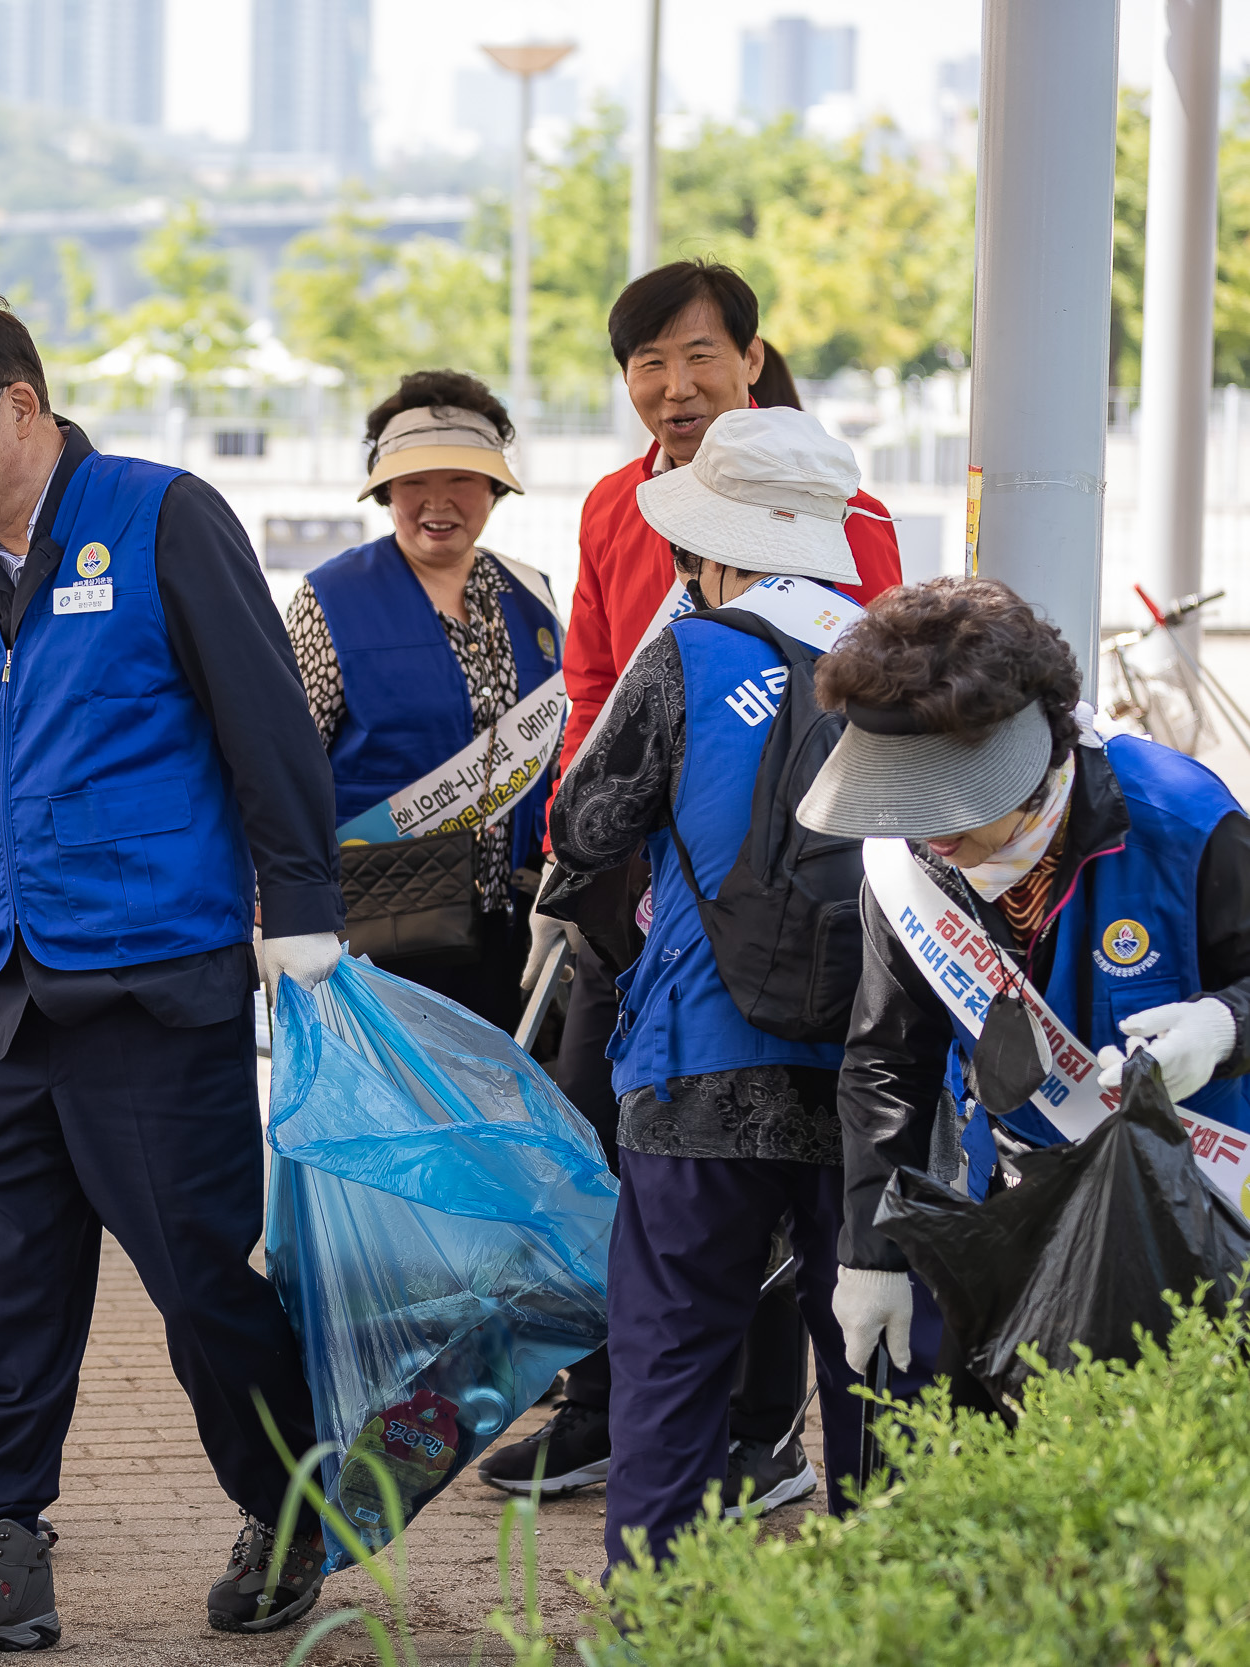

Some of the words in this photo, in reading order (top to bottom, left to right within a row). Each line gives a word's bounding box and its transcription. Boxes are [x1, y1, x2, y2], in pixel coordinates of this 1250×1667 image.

[74, 588, 106, 601] 김경호
[516, 692, 567, 742] 운동
[391, 738, 513, 836] 광진구협의회
[424, 756, 541, 838] 새정신국민
[899, 906, 1071, 1107] 국토대청동
